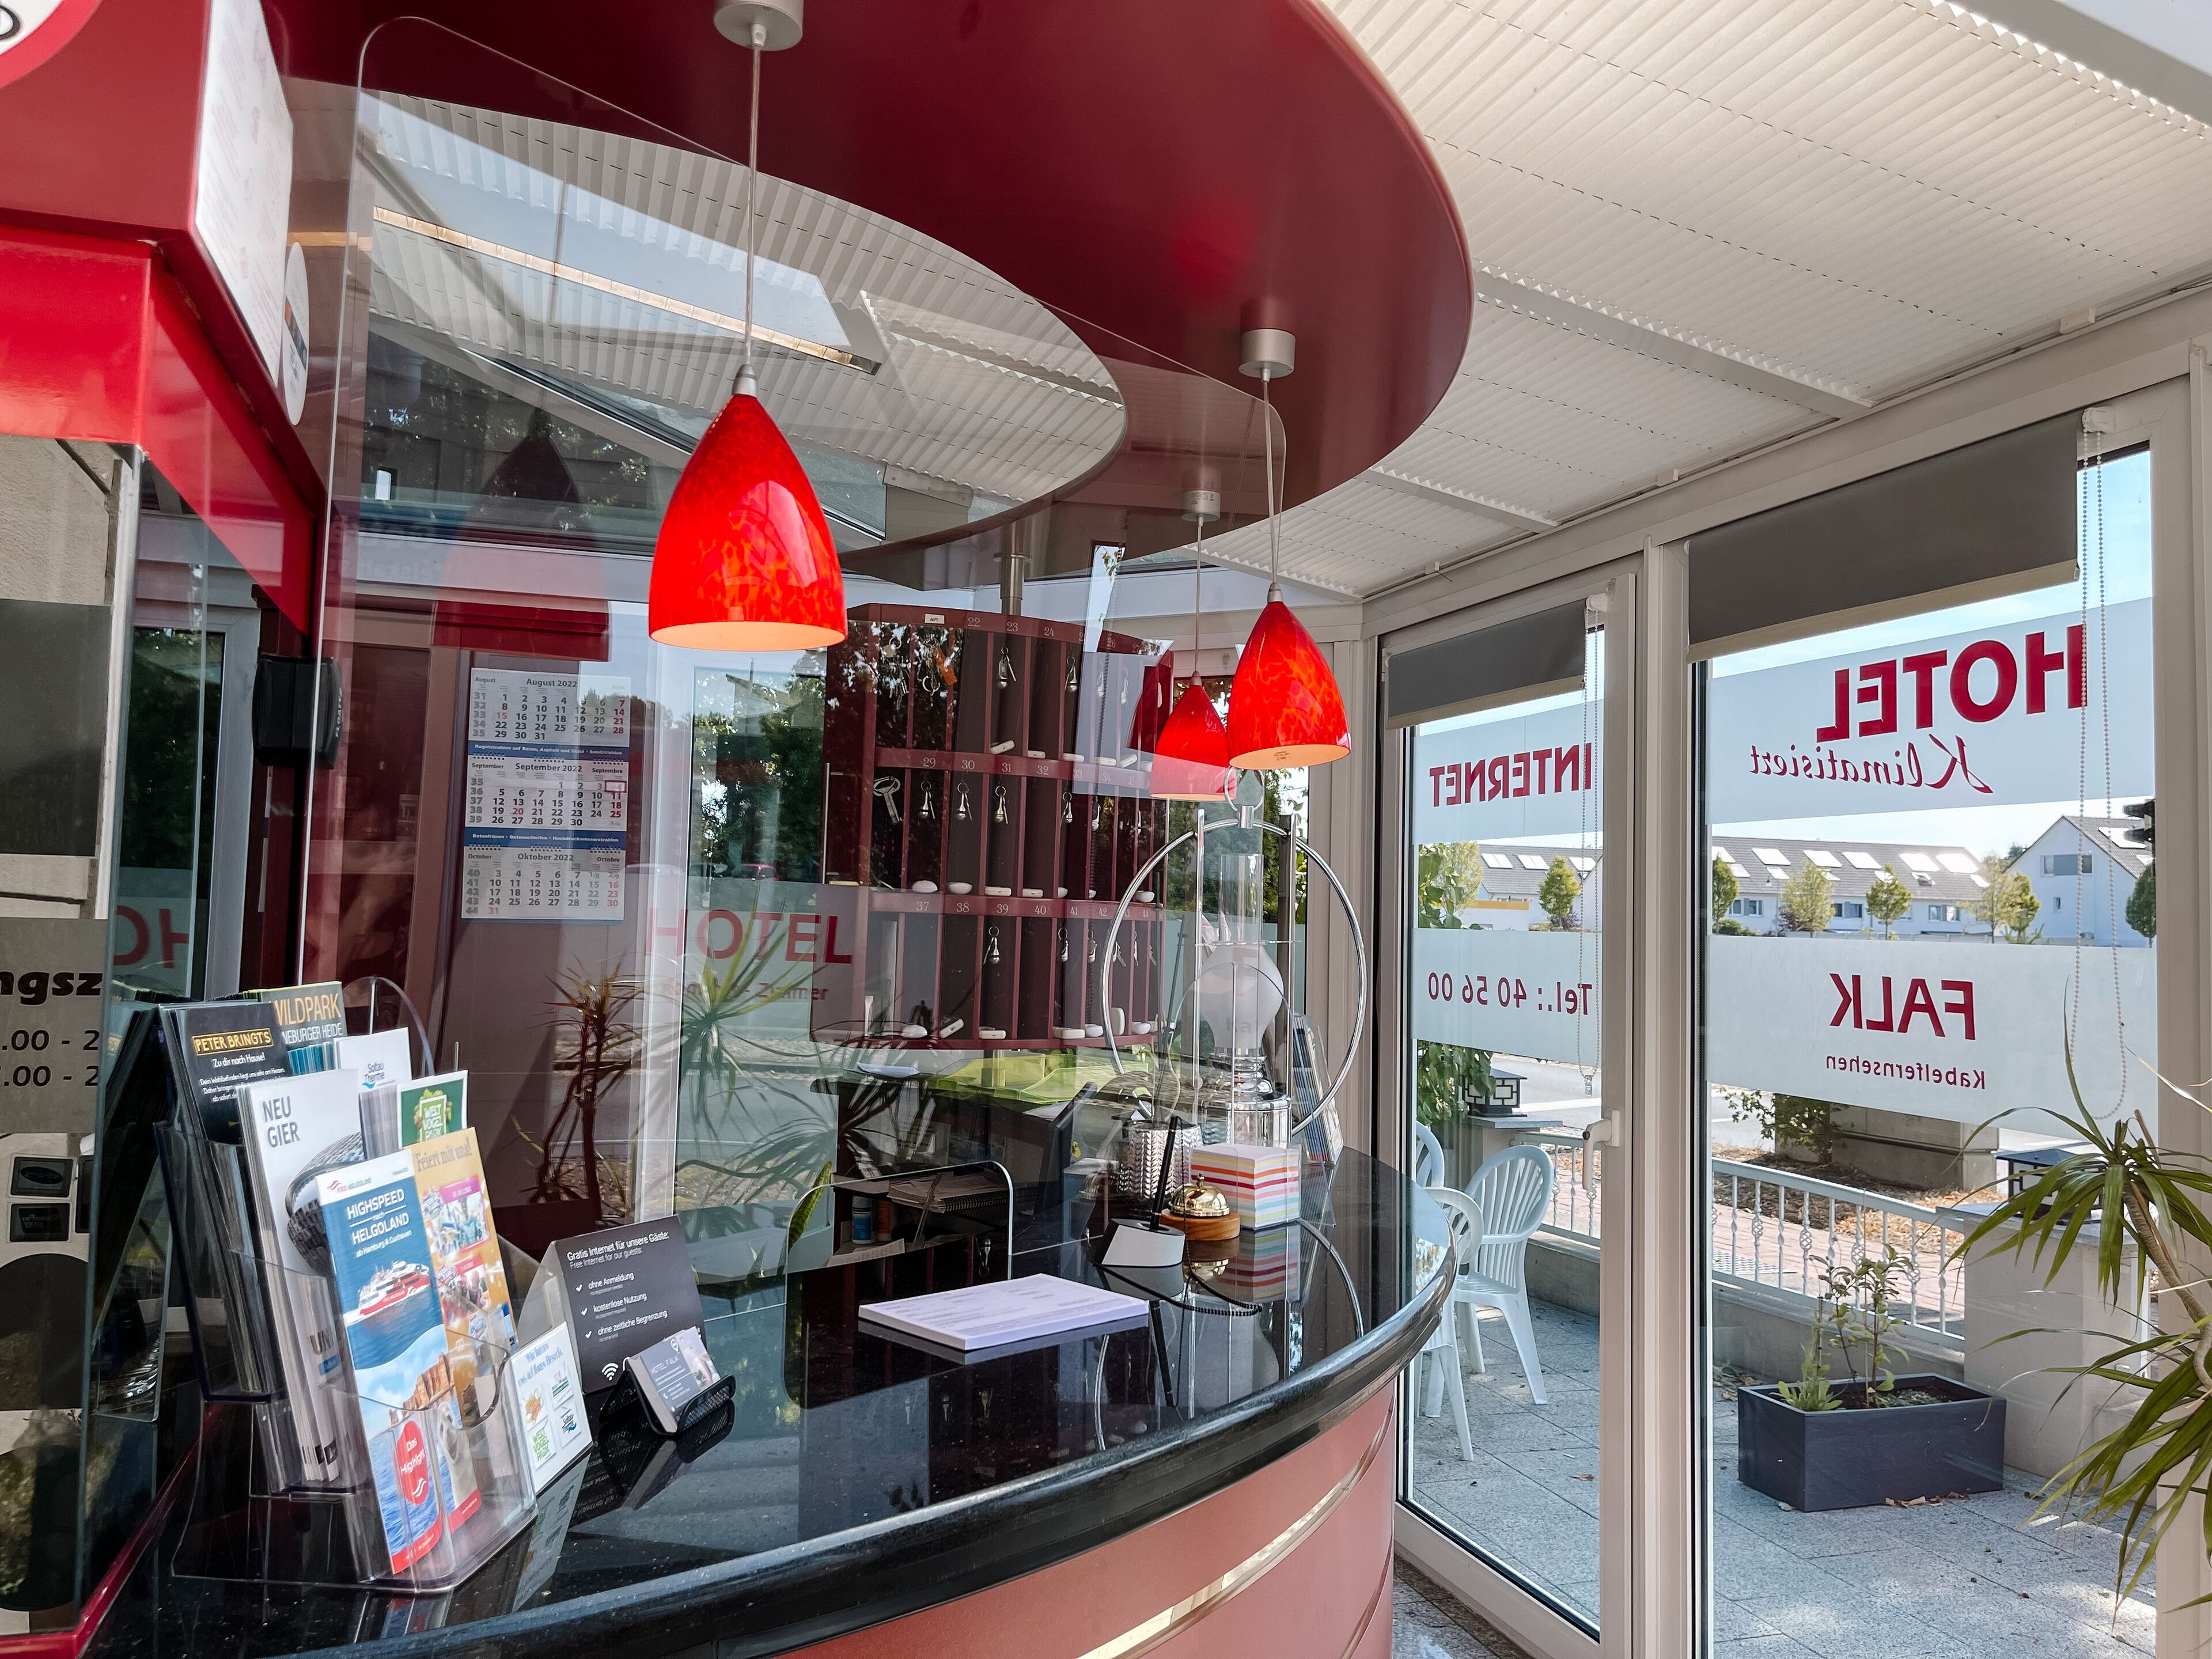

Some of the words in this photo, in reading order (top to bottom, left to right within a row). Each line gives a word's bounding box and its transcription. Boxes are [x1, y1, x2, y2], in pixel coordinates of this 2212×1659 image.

[968, 617, 980, 627] 22
[1006, 622, 1018, 632] 23
[1044, 627, 1055, 637] 24
[1078, 632, 1084, 641] 2
[1107, 638, 1116, 648] 26
[1132, 644, 1139, 653] 27
[527, 679, 555, 687] August
[516, 763, 560, 771] September
[923, 757, 936, 769] 29
[961, 760, 975, 770] 30
[1002, 763, 1012, 772] 31
[1037, 765, 1048, 775] 32
[1073, 769, 1083, 779] 33
[1102, 772, 1111, 782] 34
[1128, 776, 1135, 785] 35
[916, 902, 929, 911] 37
[956, 902, 969, 912] 38
[997, 904, 1009, 915] 39
[1035, 906, 1047, 915] 40
[1070, 907, 1078, 916] 41
[1099, 907, 1107, 917] 42
[1124, 908, 1130, 918] 3
[1142, 910, 1149, 918] 44
[645, 908, 853, 964] HOTEL
[323, 1022, 343, 1038] HEIDE
[194, 1036, 228, 1052] PETER
[212, 1058, 222, 1068] Zu
[222, 1055, 230, 1066] dir
[230, 1054, 246, 1065] nach
[246, 1052, 266, 1063] Hause!
[368, 1062, 384, 1073] Soltau
[364, 1071, 385, 1082] Therme
[262, 1096, 291, 1123] NEU
[267, 1121, 301, 1148] GIER
[415, 1150, 441, 1172] Feiert
[441, 1144, 455, 1164] mit
[346, 1188, 405, 1220] HIGHSPEED
[351, 1212, 410, 1245] HELGOLAND
[355, 1249, 363, 1258] ab
[363, 1240, 386, 1254] Hamburg
[567, 1249, 589, 1262] Gratis
[589, 1243, 616, 1256] Internet
[615, 1240, 626, 1251] für
[626, 1236, 649, 1248] unsere
[648, 1231, 670, 1243] Gäste:
[569, 1260, 584, 1270] Free
[583, 1255, 605, 1267] Internet
[604, 1253, 613, 1262] for
[613, 1251, 623, 1260] our
[588, 1280, 603, 1290] ohne
[603, 1271, 634, 1286] Anmeldung
[593, 1297, 623, 1313] kostenlose
[623, 1292, 647, 1305] Nutzung
[597, 1326, 613, 1336] ohne
[612, 1318, 636, 1331] zeitliche
[635, 1309, 668, 1325] Begrenzung
[406, 1437, 418, 1452] Das
